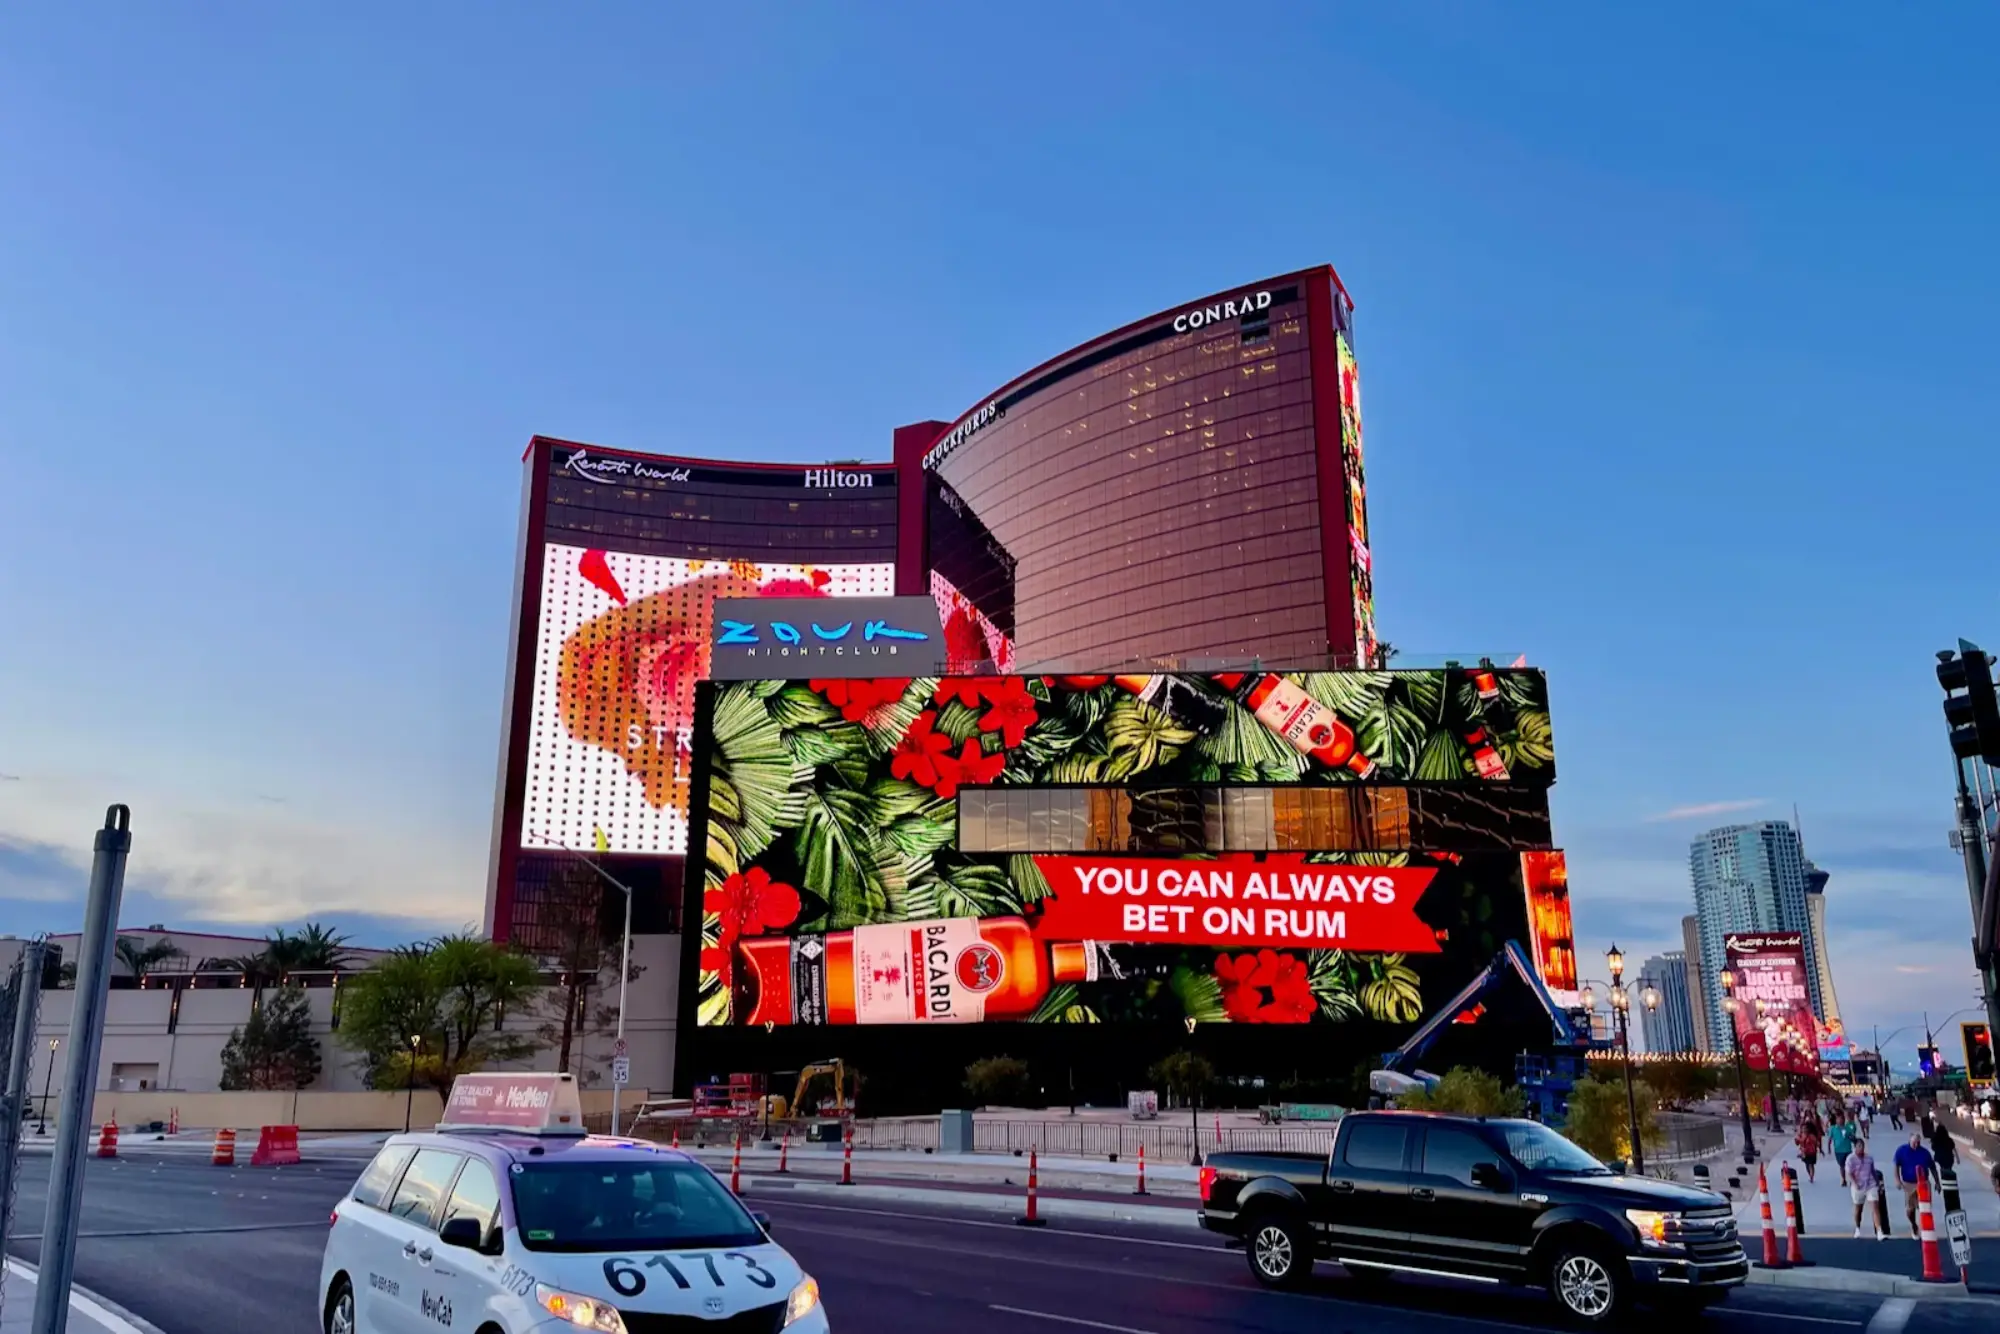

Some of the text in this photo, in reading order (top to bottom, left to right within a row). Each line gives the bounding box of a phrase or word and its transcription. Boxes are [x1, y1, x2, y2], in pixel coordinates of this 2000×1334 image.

[1173, 291, 1272, 332] CONRAD
[922, 399, 996, 470] CROCKFORDS
[565, 449, 691, 484] Resorts World
[804, 468, 874, 488] Hilton
[747, 646, 898, 656] NIGHTCLUB
[1073, 867, 1396, 904] YOU CAN ALWAYS
[1123, 904, 1346, 939] BET ON RUM
[914, 952, 924, 995] SPICED
[615, 1071, 627, 1081] 35
[505, 1085, 549, 1109] MedMen
[501, 1264, 536, 1297] 6173
[602, 1253, 776, 1297] 6173
[420, 1288, 453, 1327] NewCab
